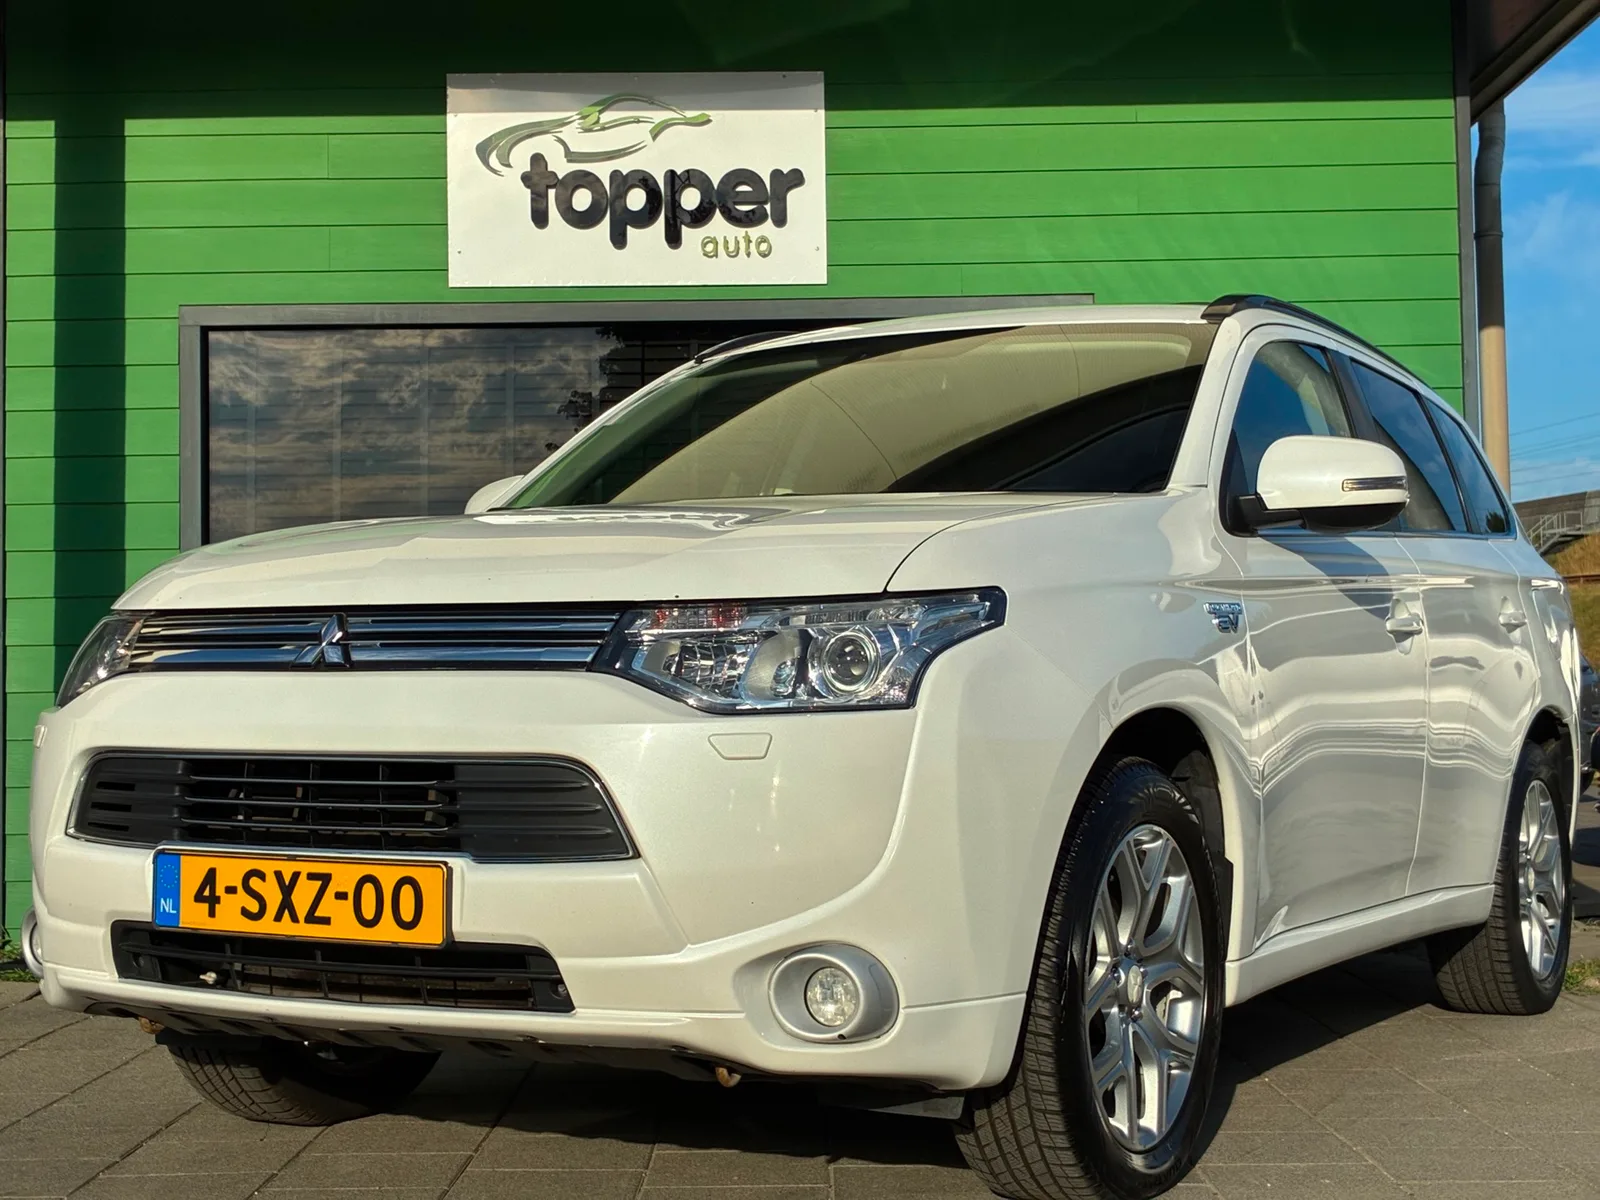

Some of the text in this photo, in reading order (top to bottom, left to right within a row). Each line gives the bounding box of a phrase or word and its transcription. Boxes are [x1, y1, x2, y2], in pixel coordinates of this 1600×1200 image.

[520, 152, 805, 250] topper
[701, 230, 772, 258] auto
[160, 897, 177, 914] NL
[193, 867, 424, 930] 4-SXZ-00
